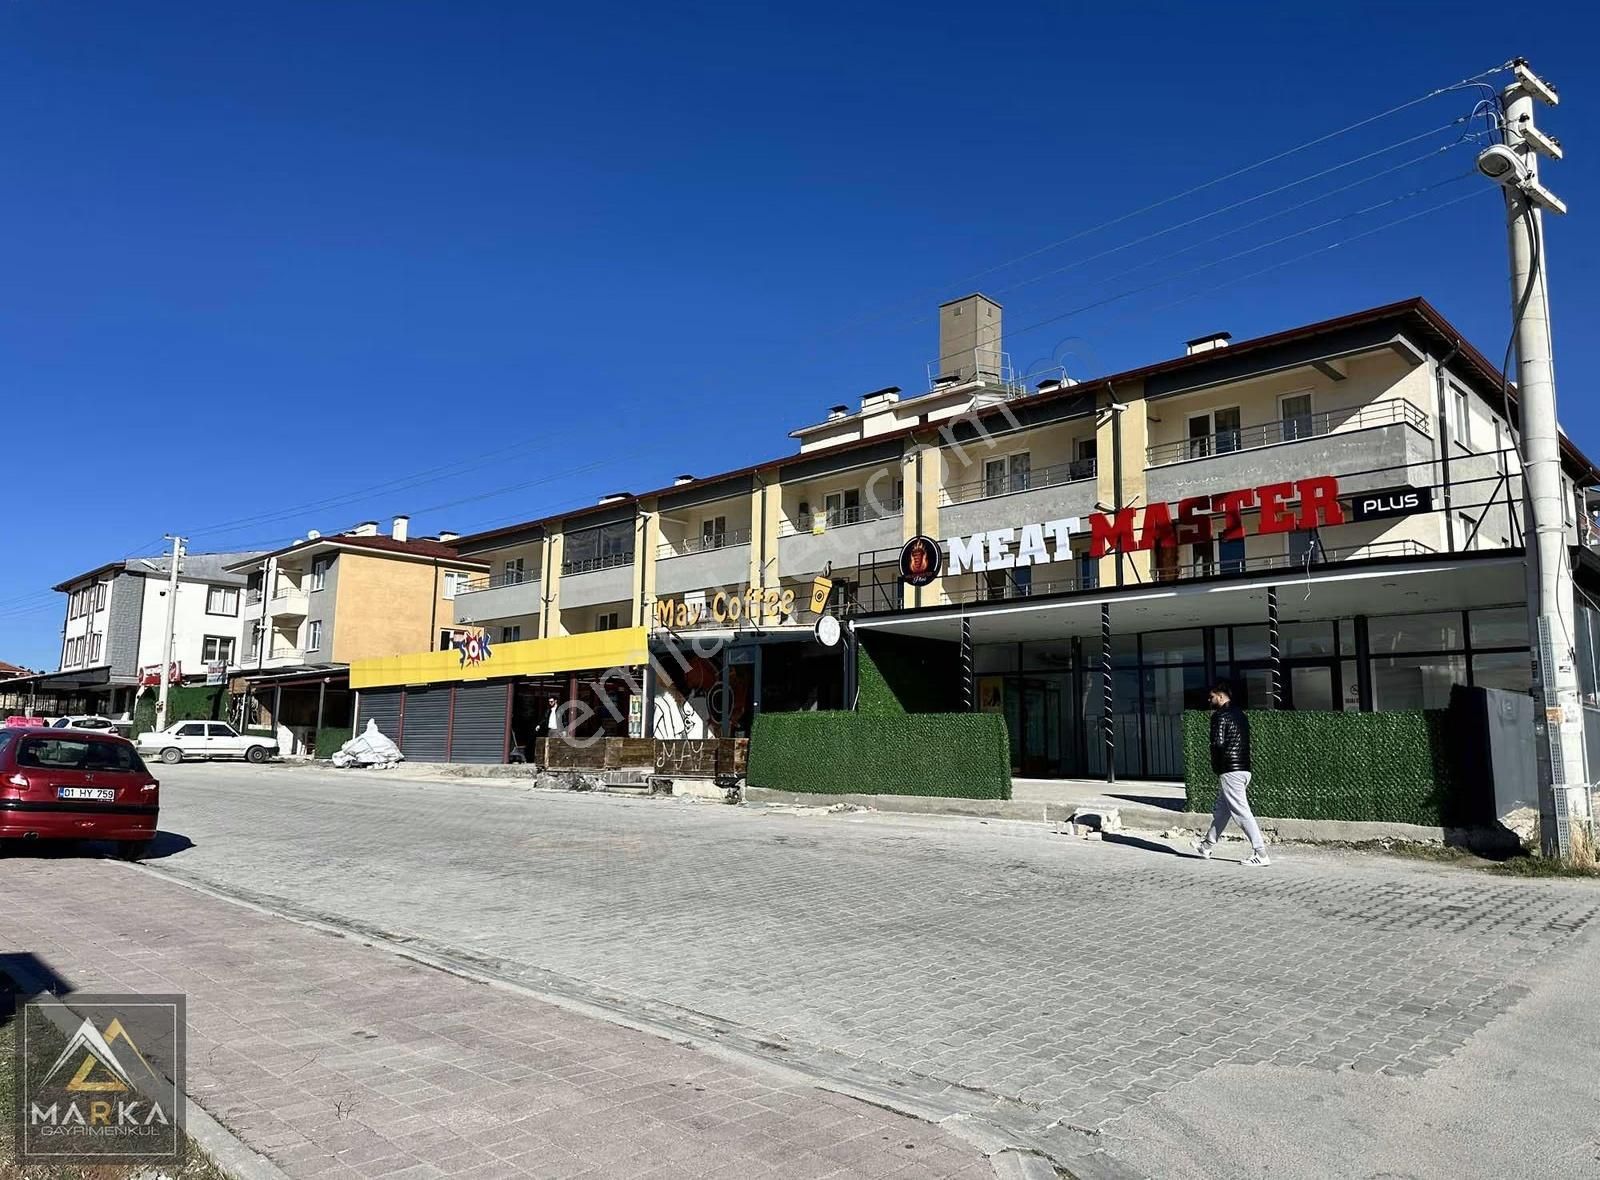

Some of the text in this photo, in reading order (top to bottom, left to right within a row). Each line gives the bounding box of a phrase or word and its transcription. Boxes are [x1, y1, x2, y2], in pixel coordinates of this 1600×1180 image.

[1363, 494, 1419, 514] PLUS
[947, 475, 1345, 576] MEAT MASTER
[656, 588, 796, 627] May Coffee
[64, 789, 114, 798] 01 HY 759
